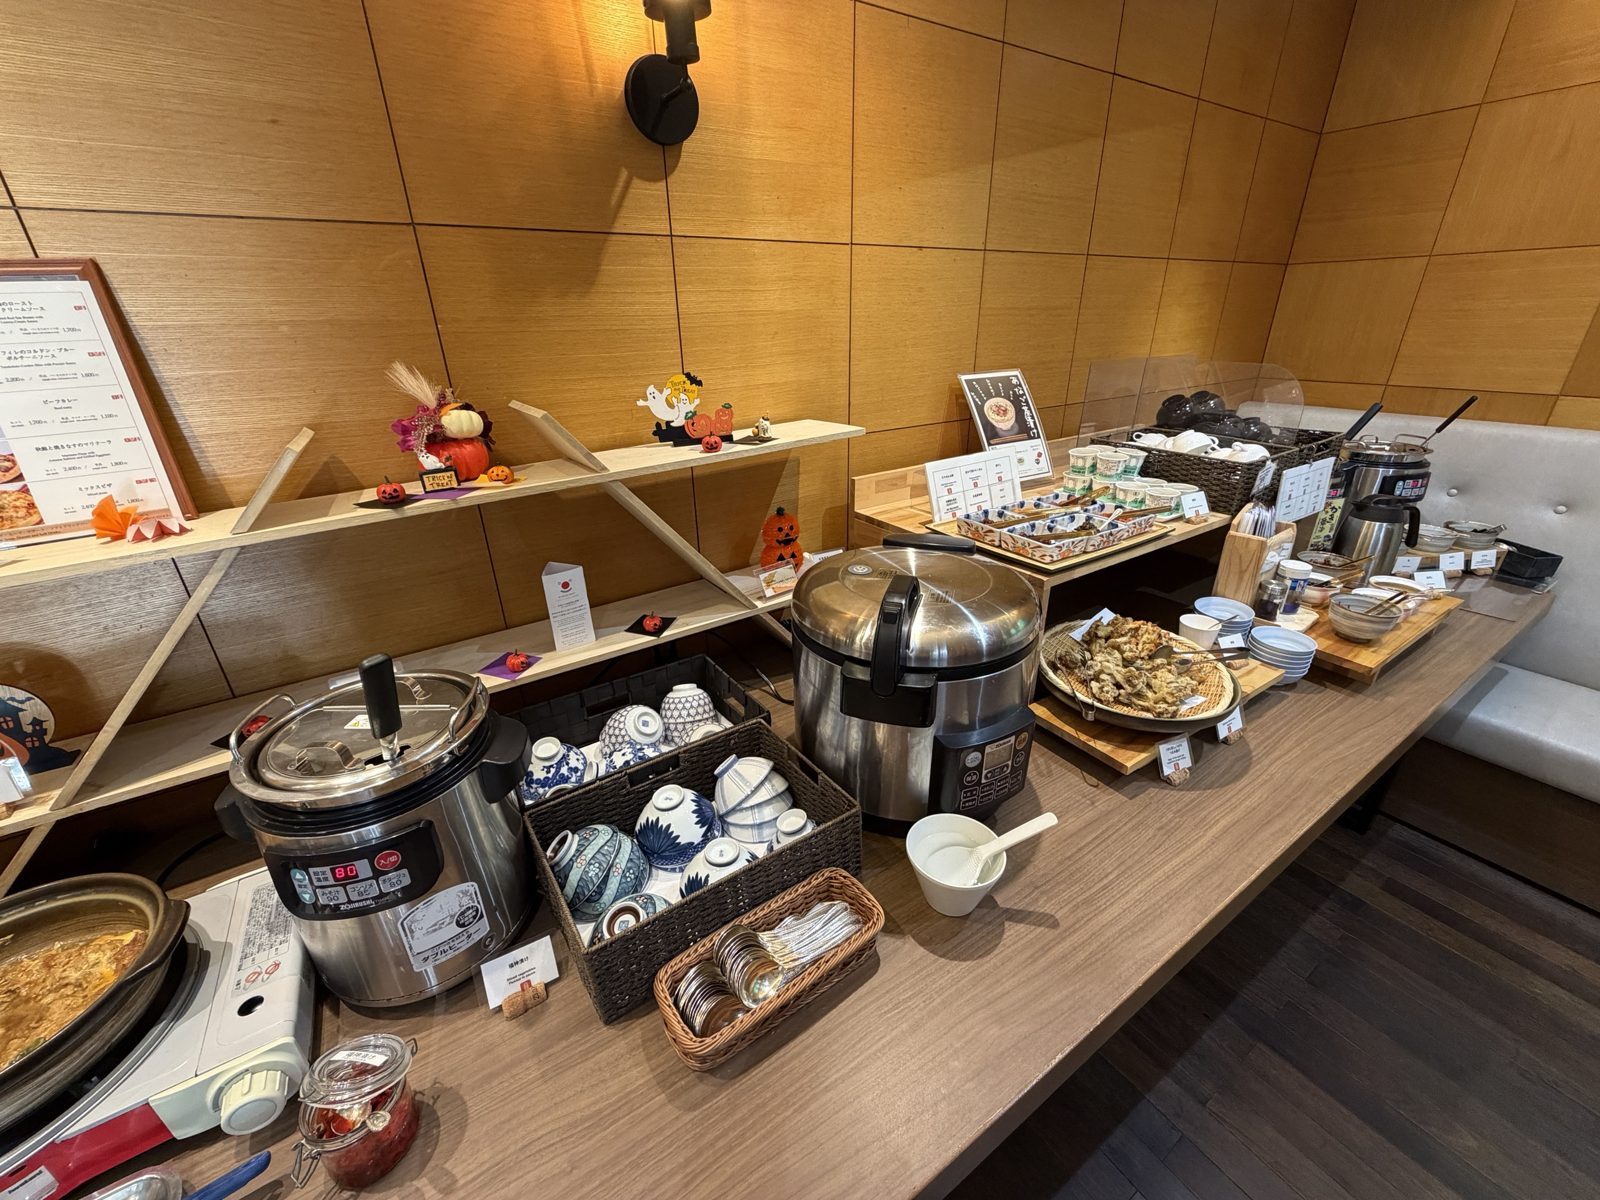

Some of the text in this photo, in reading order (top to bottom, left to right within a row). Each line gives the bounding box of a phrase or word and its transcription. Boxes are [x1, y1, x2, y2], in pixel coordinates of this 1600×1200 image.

[425, 474, 446, 482] TRICK
[429, 480, 453, 488] TREAT
[380, 855, 398, 866] 入/切
[335, 866, 357, 879] 80
[349, 883, 375, 893] コンソメ
[389, 880, 403, 888] 80
[321, 889, 342, 897] みそ汁
[421, 928, 481, 964] ダブルヒーター
